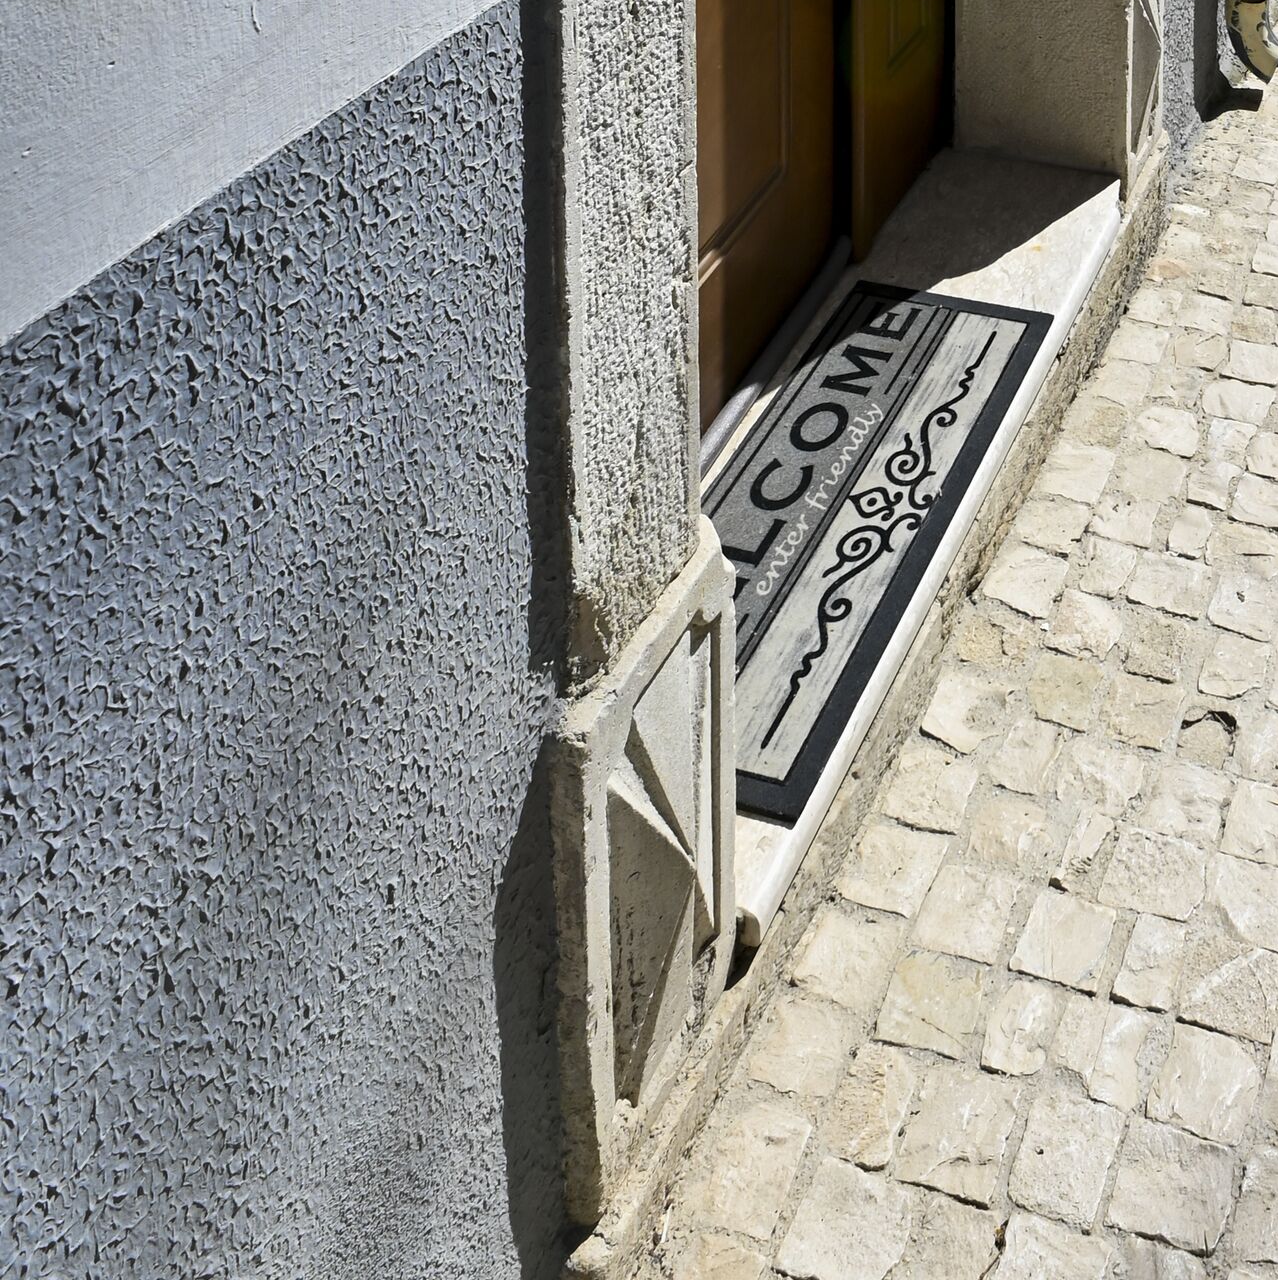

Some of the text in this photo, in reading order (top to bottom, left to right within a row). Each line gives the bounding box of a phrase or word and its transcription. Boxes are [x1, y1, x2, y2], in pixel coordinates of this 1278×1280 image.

[721, 301, 922, 602] LCOME
[756, 403, 884, 595] enter friendly
